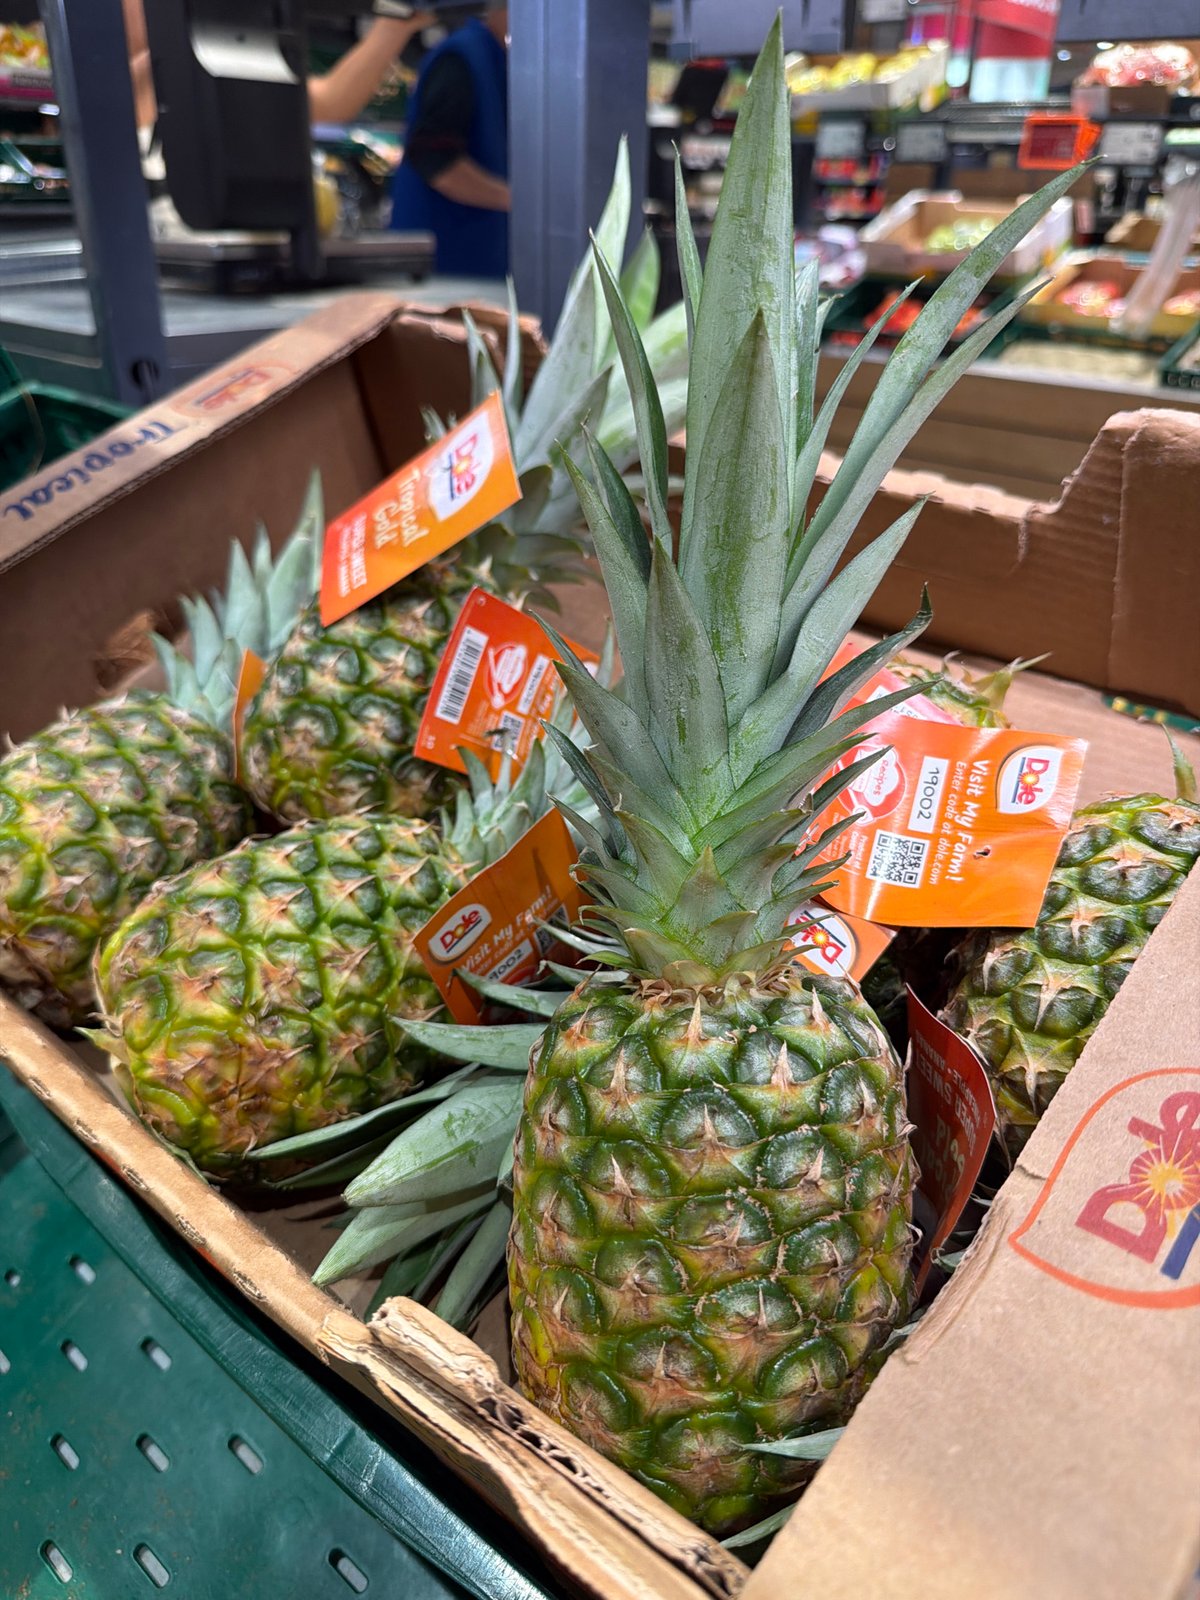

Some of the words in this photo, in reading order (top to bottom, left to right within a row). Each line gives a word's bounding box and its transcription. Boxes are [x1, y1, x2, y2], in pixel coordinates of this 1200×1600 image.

[4, 421, 174, 520] Tropical
[453, 432, 481, 496] Dole
[373, 500, 400, 549] Gold
[398, 468, 430, 547] Tropical
[916, 767, 940, 820] 19002
[952, 761, 968, 790] Enter
[966, 760, 991, 797] Visit
[1017, 757, 1050, 805] Dole
[941, 823, 952, 834] at
[944, 794, 957, 819] code
[953, 801, 981, 829] My
[929, 838, 953, 886] dole.com
[944, 832, 974, 882] Farm!
[440, 910, 481, 949] Dole
[493, 924, 513, 946] My
[1075, 1091, 1200, 1264] Dole
